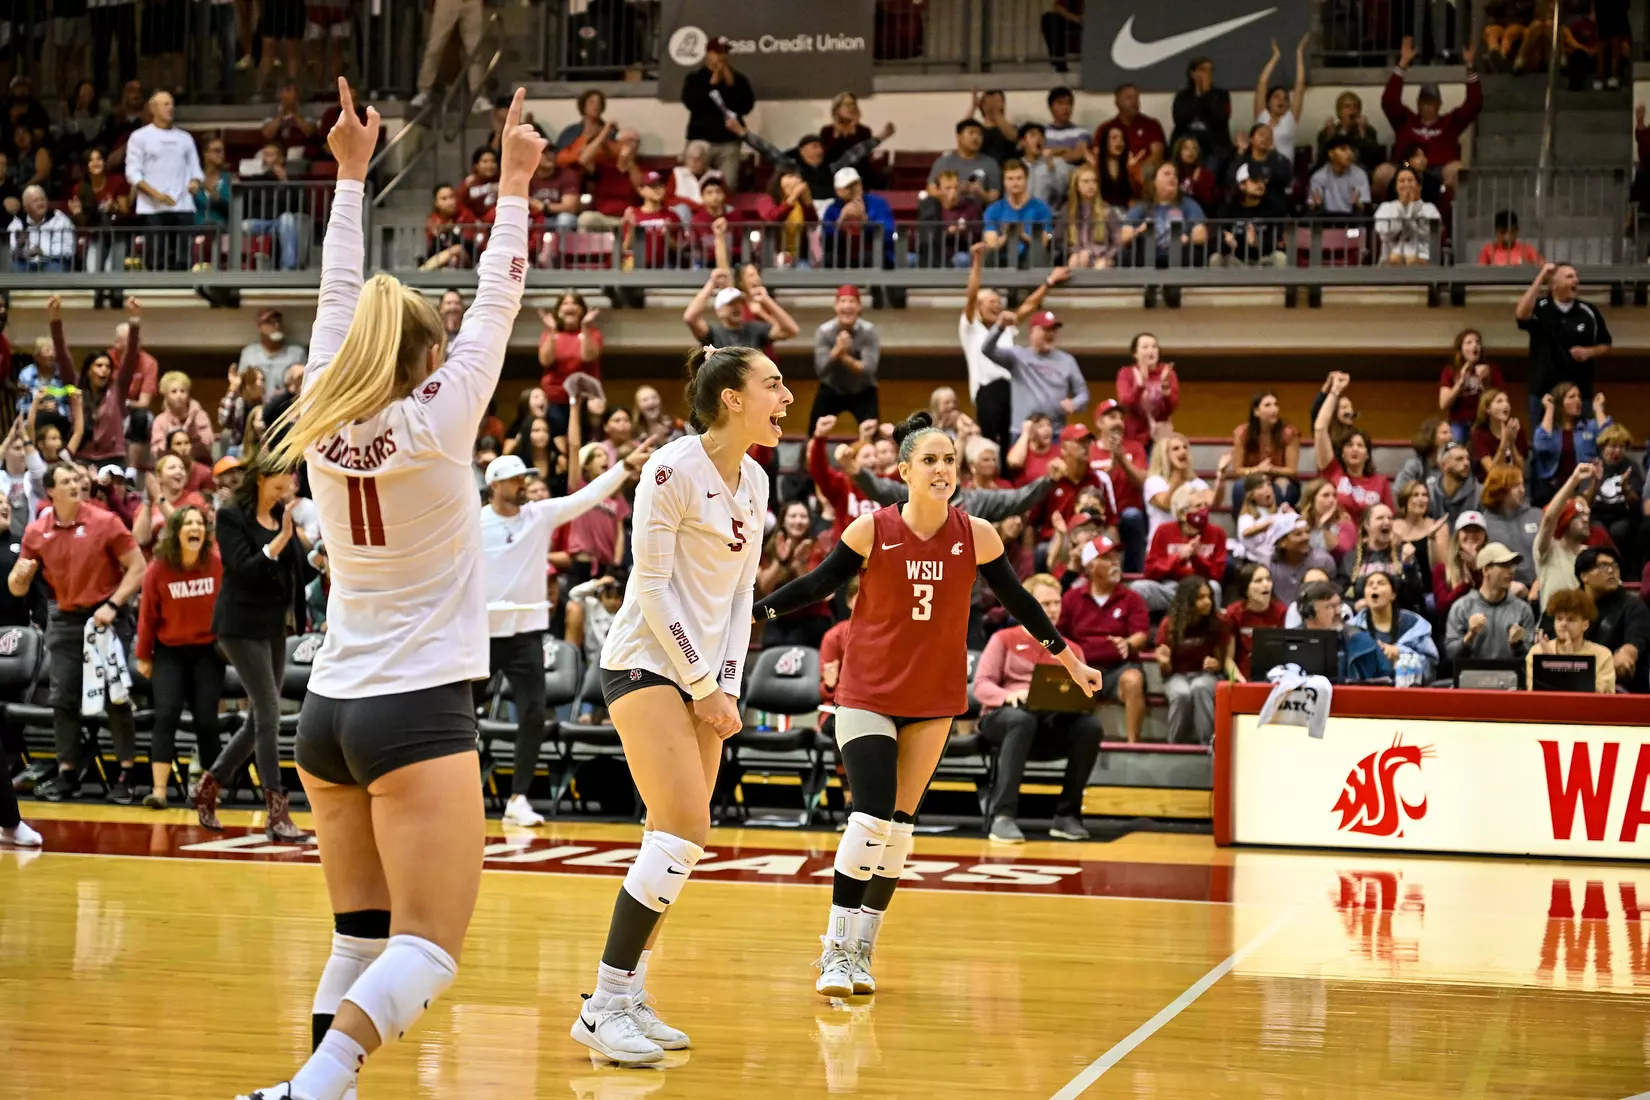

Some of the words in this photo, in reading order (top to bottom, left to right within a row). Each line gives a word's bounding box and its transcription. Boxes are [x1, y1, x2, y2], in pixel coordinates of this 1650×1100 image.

[758, 33, 813, 53] Credit
[815, 32, 865, 53] Union
[344, 475, 386, 546] 11
[727, 517, 747, 552] 5
[168, 576, 214, 600] WAZZU
[905, 560, 943, 581] WSU
[911, 583, 934, 621] 3
[668, 621, 700, 665] COUGARS
[724, 659, 737, 680] WSU
[180, 833, 1083, 887] CUGARS
